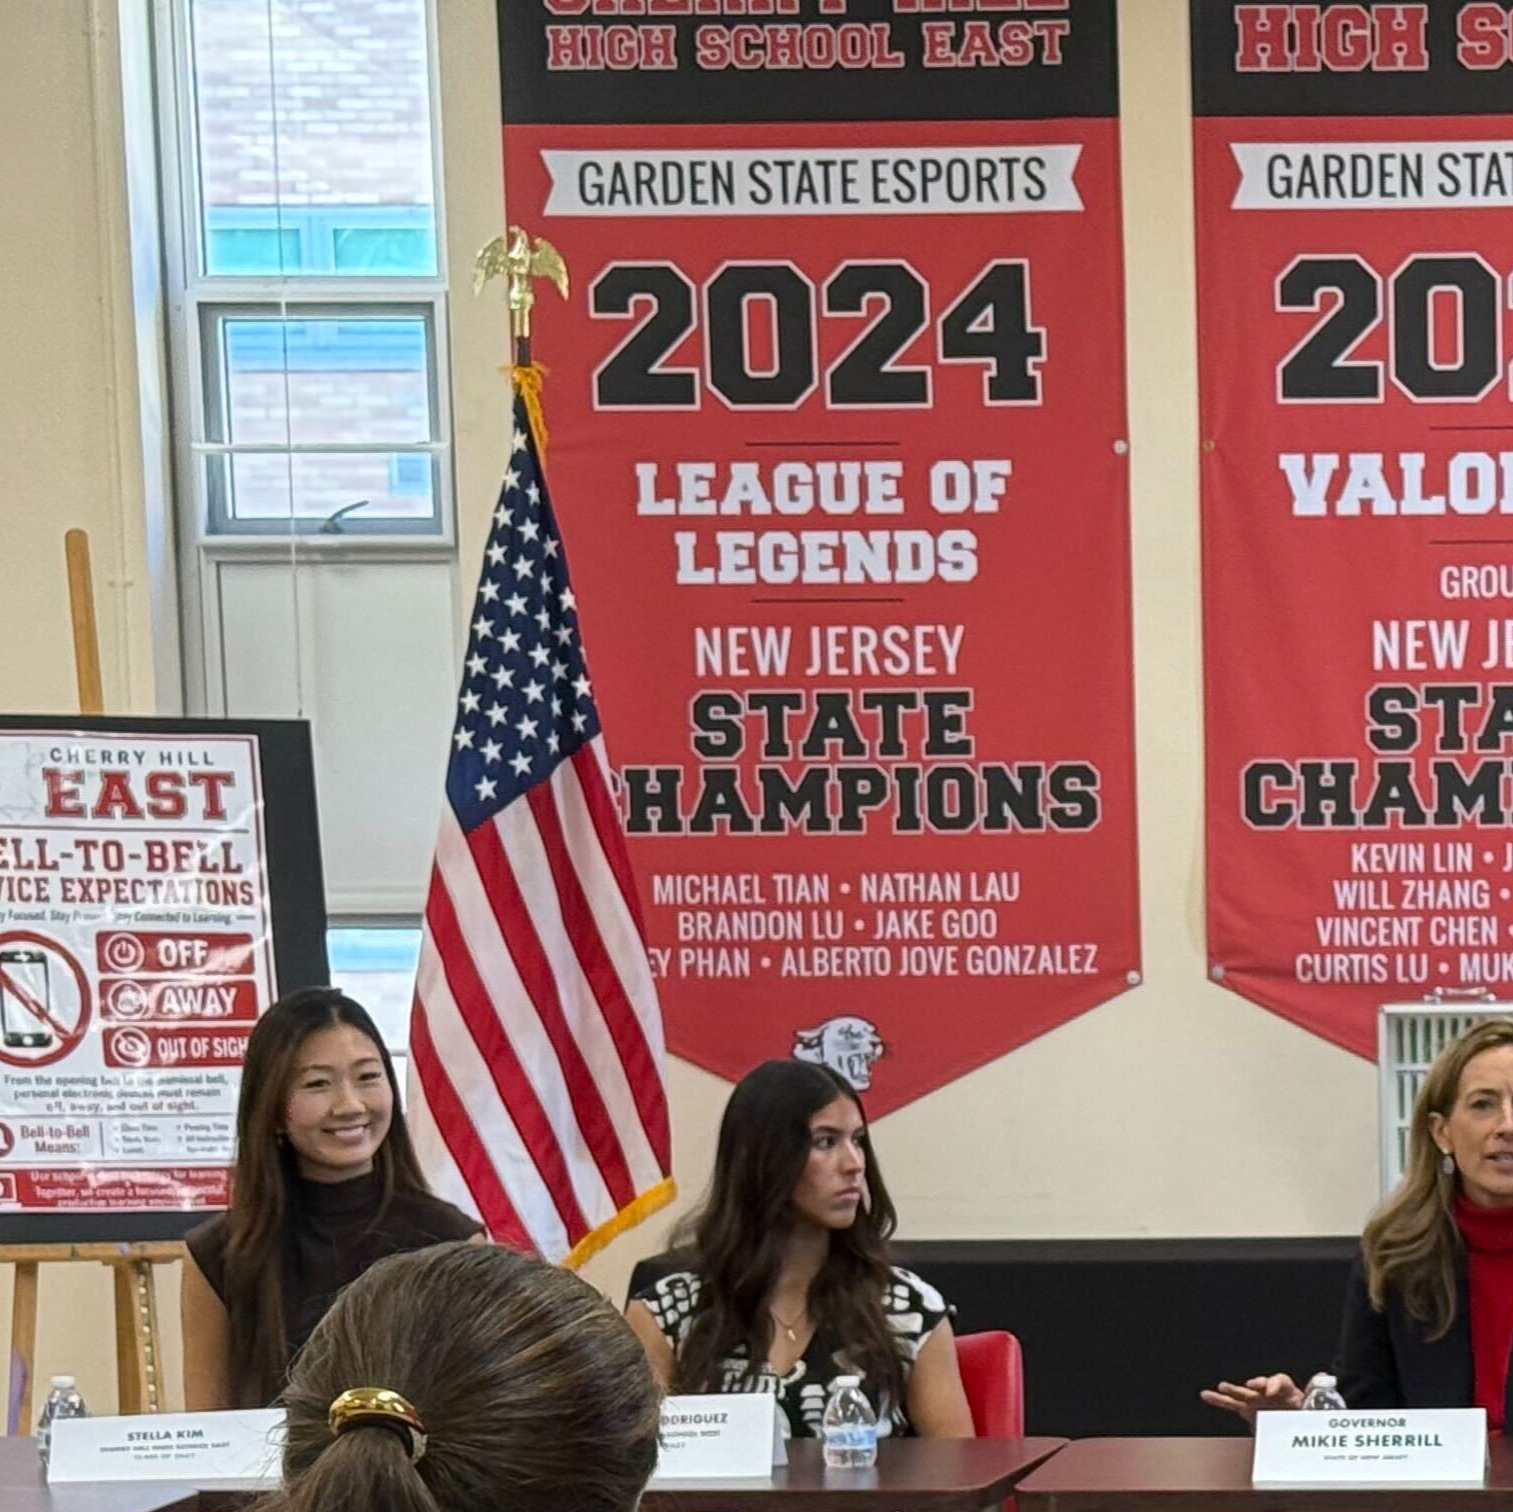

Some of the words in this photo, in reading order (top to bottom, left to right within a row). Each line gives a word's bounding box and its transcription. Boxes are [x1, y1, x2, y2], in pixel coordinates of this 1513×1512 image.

[546, 25, 677, 70] HIGH
[696, 23, 904, 70] SCHOOL
[922, 19, 1070, 67] EAST
[1235, 4, 1429, 72] HIGH
[578, 160, 734, 206] GARDEN
[748, 158, 859, 205] STATE
[873, 156, 1047, 203] ESPORTS
[1267, 153, 1423, 199] GARDEN
[588, 258, 1047, 411] 2024
[635, 461, 905, 516] LEAGUE
[930, 459, 1012, 514] OF
[674, 529, 978, 585] LEGENDS
[694, 626, 791, 677] NEW
[805, 625, 965, 676] JERSEY
[1372, 619, 1469, 671] NEW
[689, 688, 975, 760] STATE
[50, 747, 146, 765] CHERRY
[159, 751, 215, 766] HILL
[42, 767, 236, 821] EAST
[610, 760, 1101, 837] HAMPIONS
[0, 838, 243, 874] LL-TO-BELL
[1351, 843, 1425, 873] KEVIN
[1433, 843, 1473, 872] LIN
[60, 877, 254, 906] EXPECTATIONS
[653, 874, 765, 905] MICHAEL
[773, 873, 829, 904] TIAN
[861, 872, 961, 903] NATHAN
[970, 871, 1020, 902] LAU
[1334, 880, 1395, 910] WILL
[1401, 879, 1490, 910] ZHANG
[678, 910, 803, 941] BRANDON
[811, 910, 844, 940] LU
[872, 909, 934, 940] JAKE
[942, 908, 997, 939] GOO
[1316, 917, 1423, 947] VINCENT
[1430, 916, 1498, 946] CHEN
[157, 938, 208, 967] OFF
[680, 947, 750, 977] PHAN
[781, 946, 891, 977] ALBERTO
[899, 945, 958, 976] JOVE
[966, 944, 1099, 975] GONZALEZ
[1296, 953, 1387, 983] CURTIS
[1396, 952, 1428, 982] LU
[162, 987, 238, 1015] AWAY
[157, 1036, 187, 1059] OUT
[190, 1036, 209, 1058] OF
[212, 1036, 248, 1059] SIGH
[20, 1124, 90, 1139] Bell-to-Bell
[127, 1430, 172, 1442] STELLA
[176, 1429, 204, 1439] KIM
[1328, 1417, 1407, 1429] GOVERNOR
[1291, 1435, 1349, 1448] MIKIE
[1354, 1433, 1443, 1448] SHERRILL
